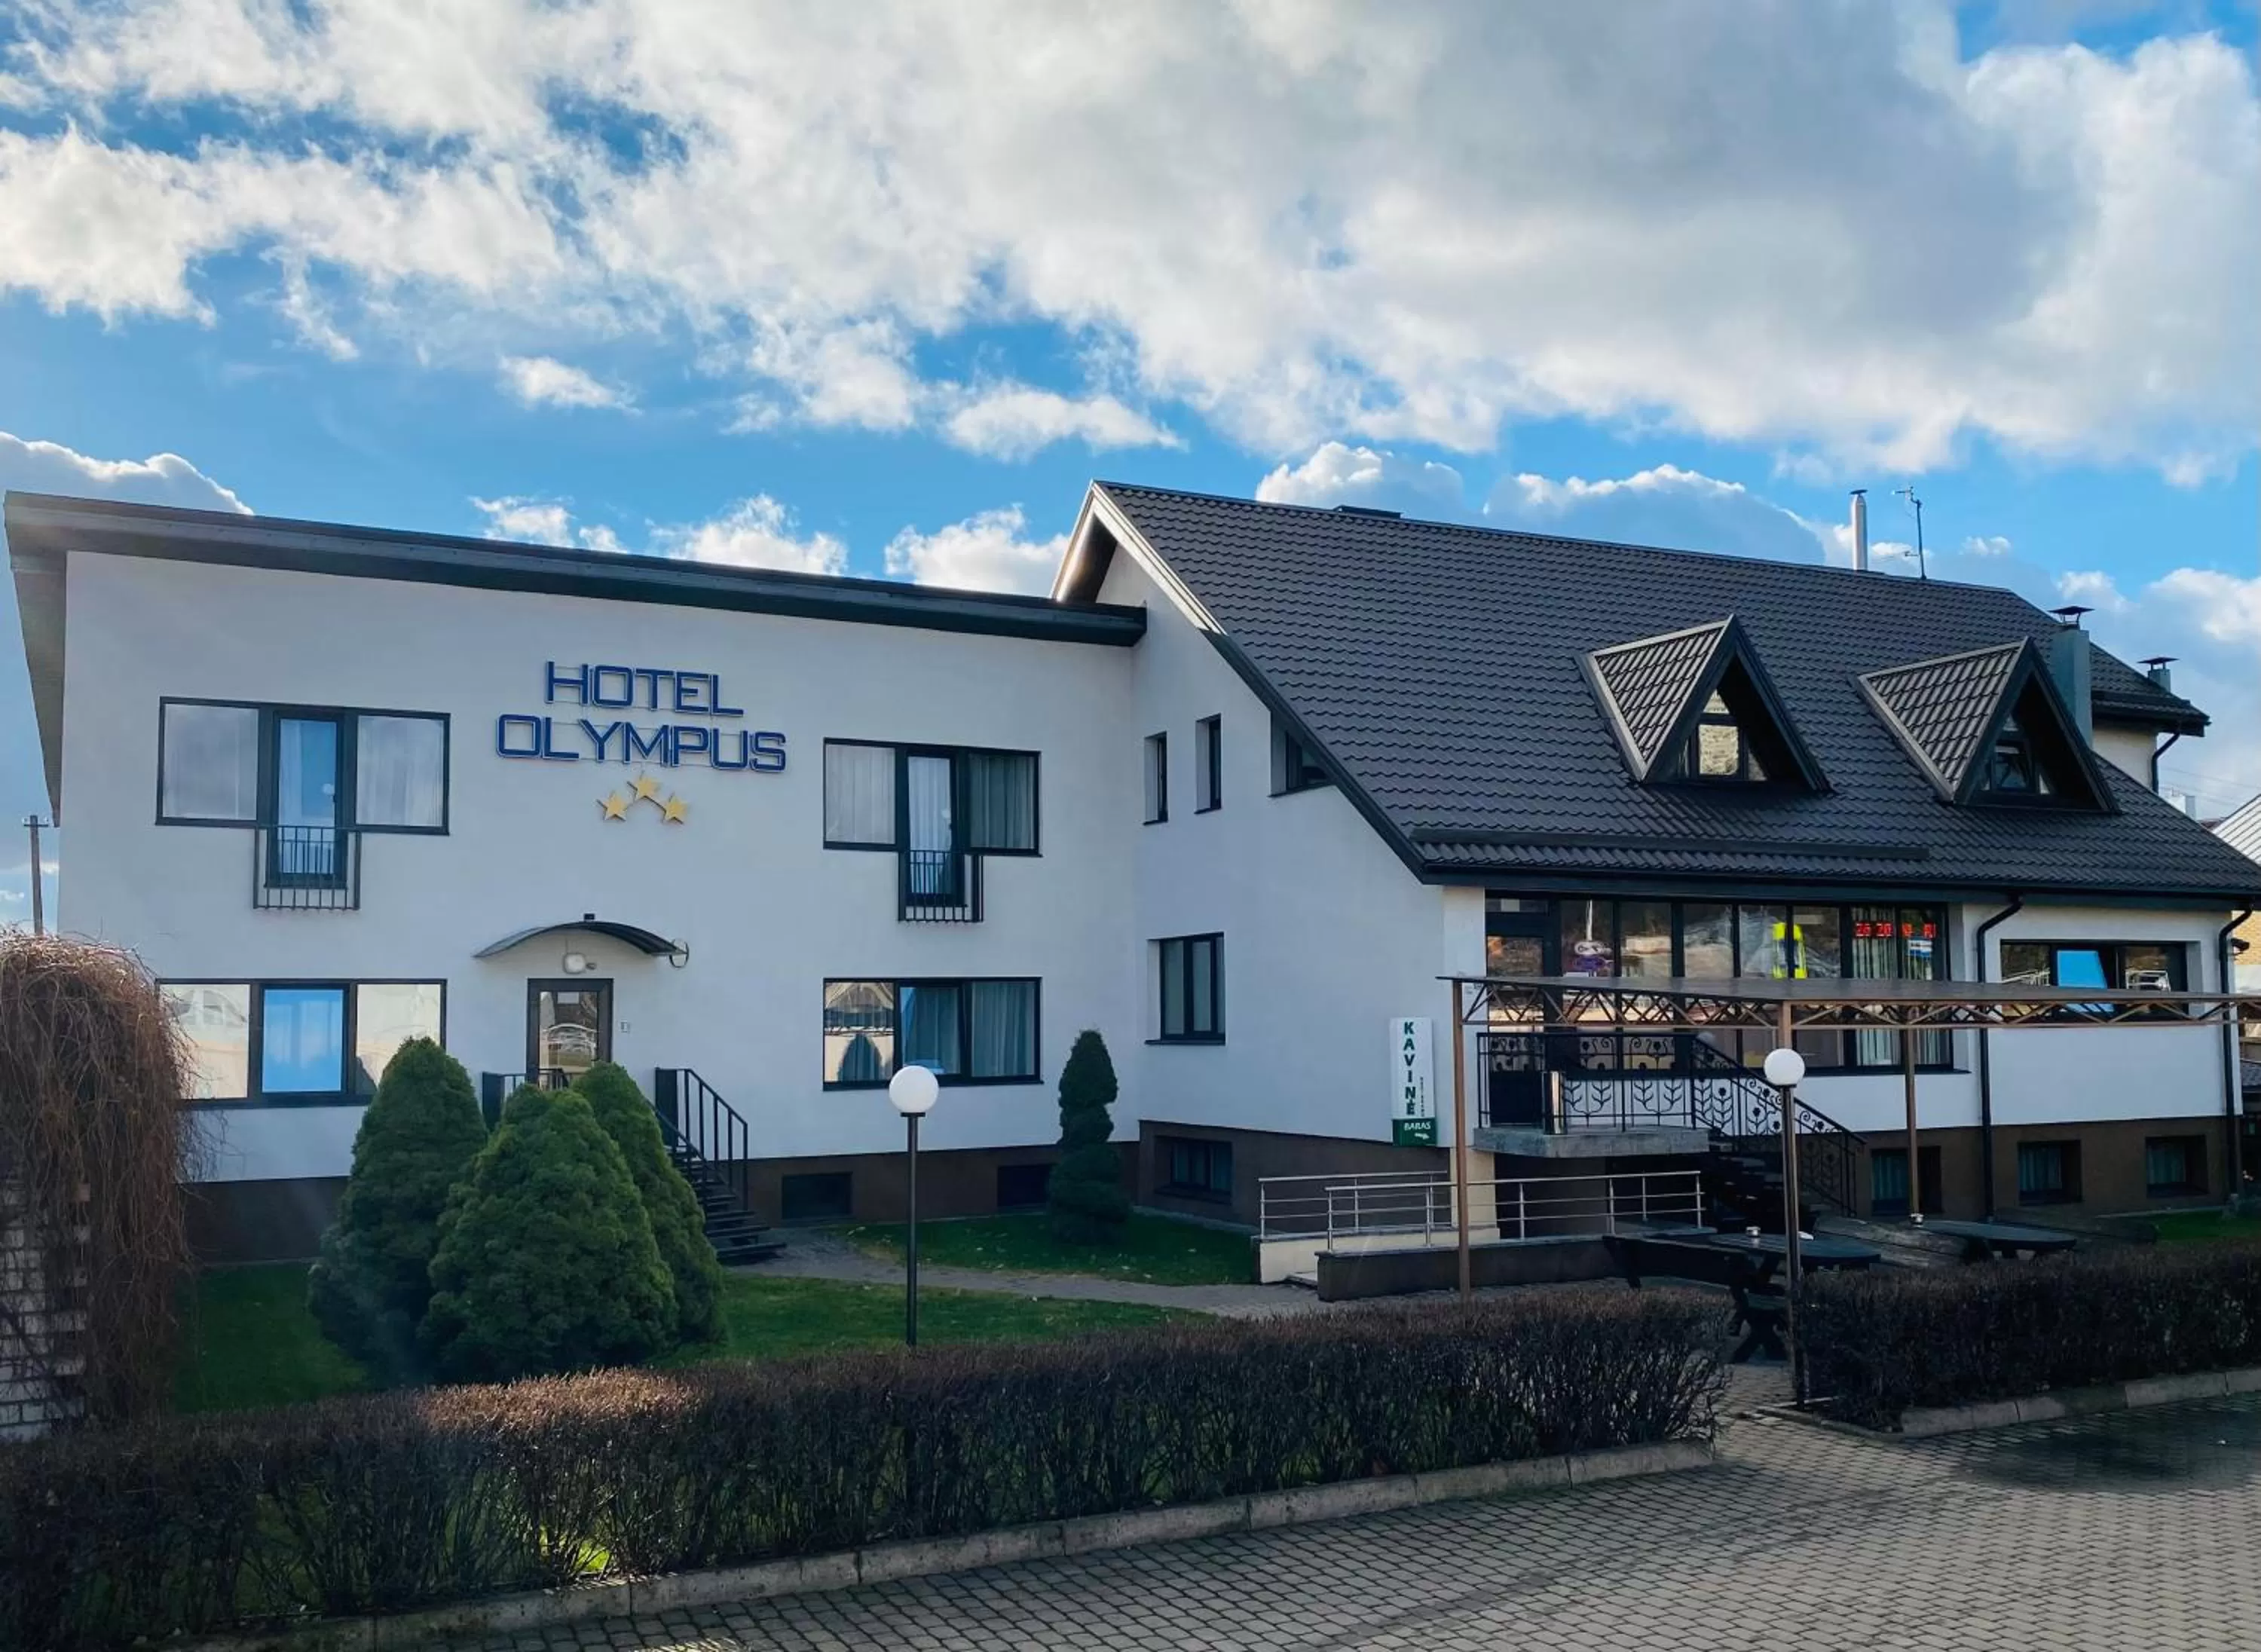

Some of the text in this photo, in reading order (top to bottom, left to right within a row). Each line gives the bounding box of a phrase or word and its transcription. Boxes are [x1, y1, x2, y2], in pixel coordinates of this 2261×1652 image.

[545, 660, 744, 717] HOTEL
[497, 714, 787, 772] OLYMPUS
[1403, 1021, 1416, 1115] KAVINĖ
[1404, 1121, 1431, 1131] BARAS
